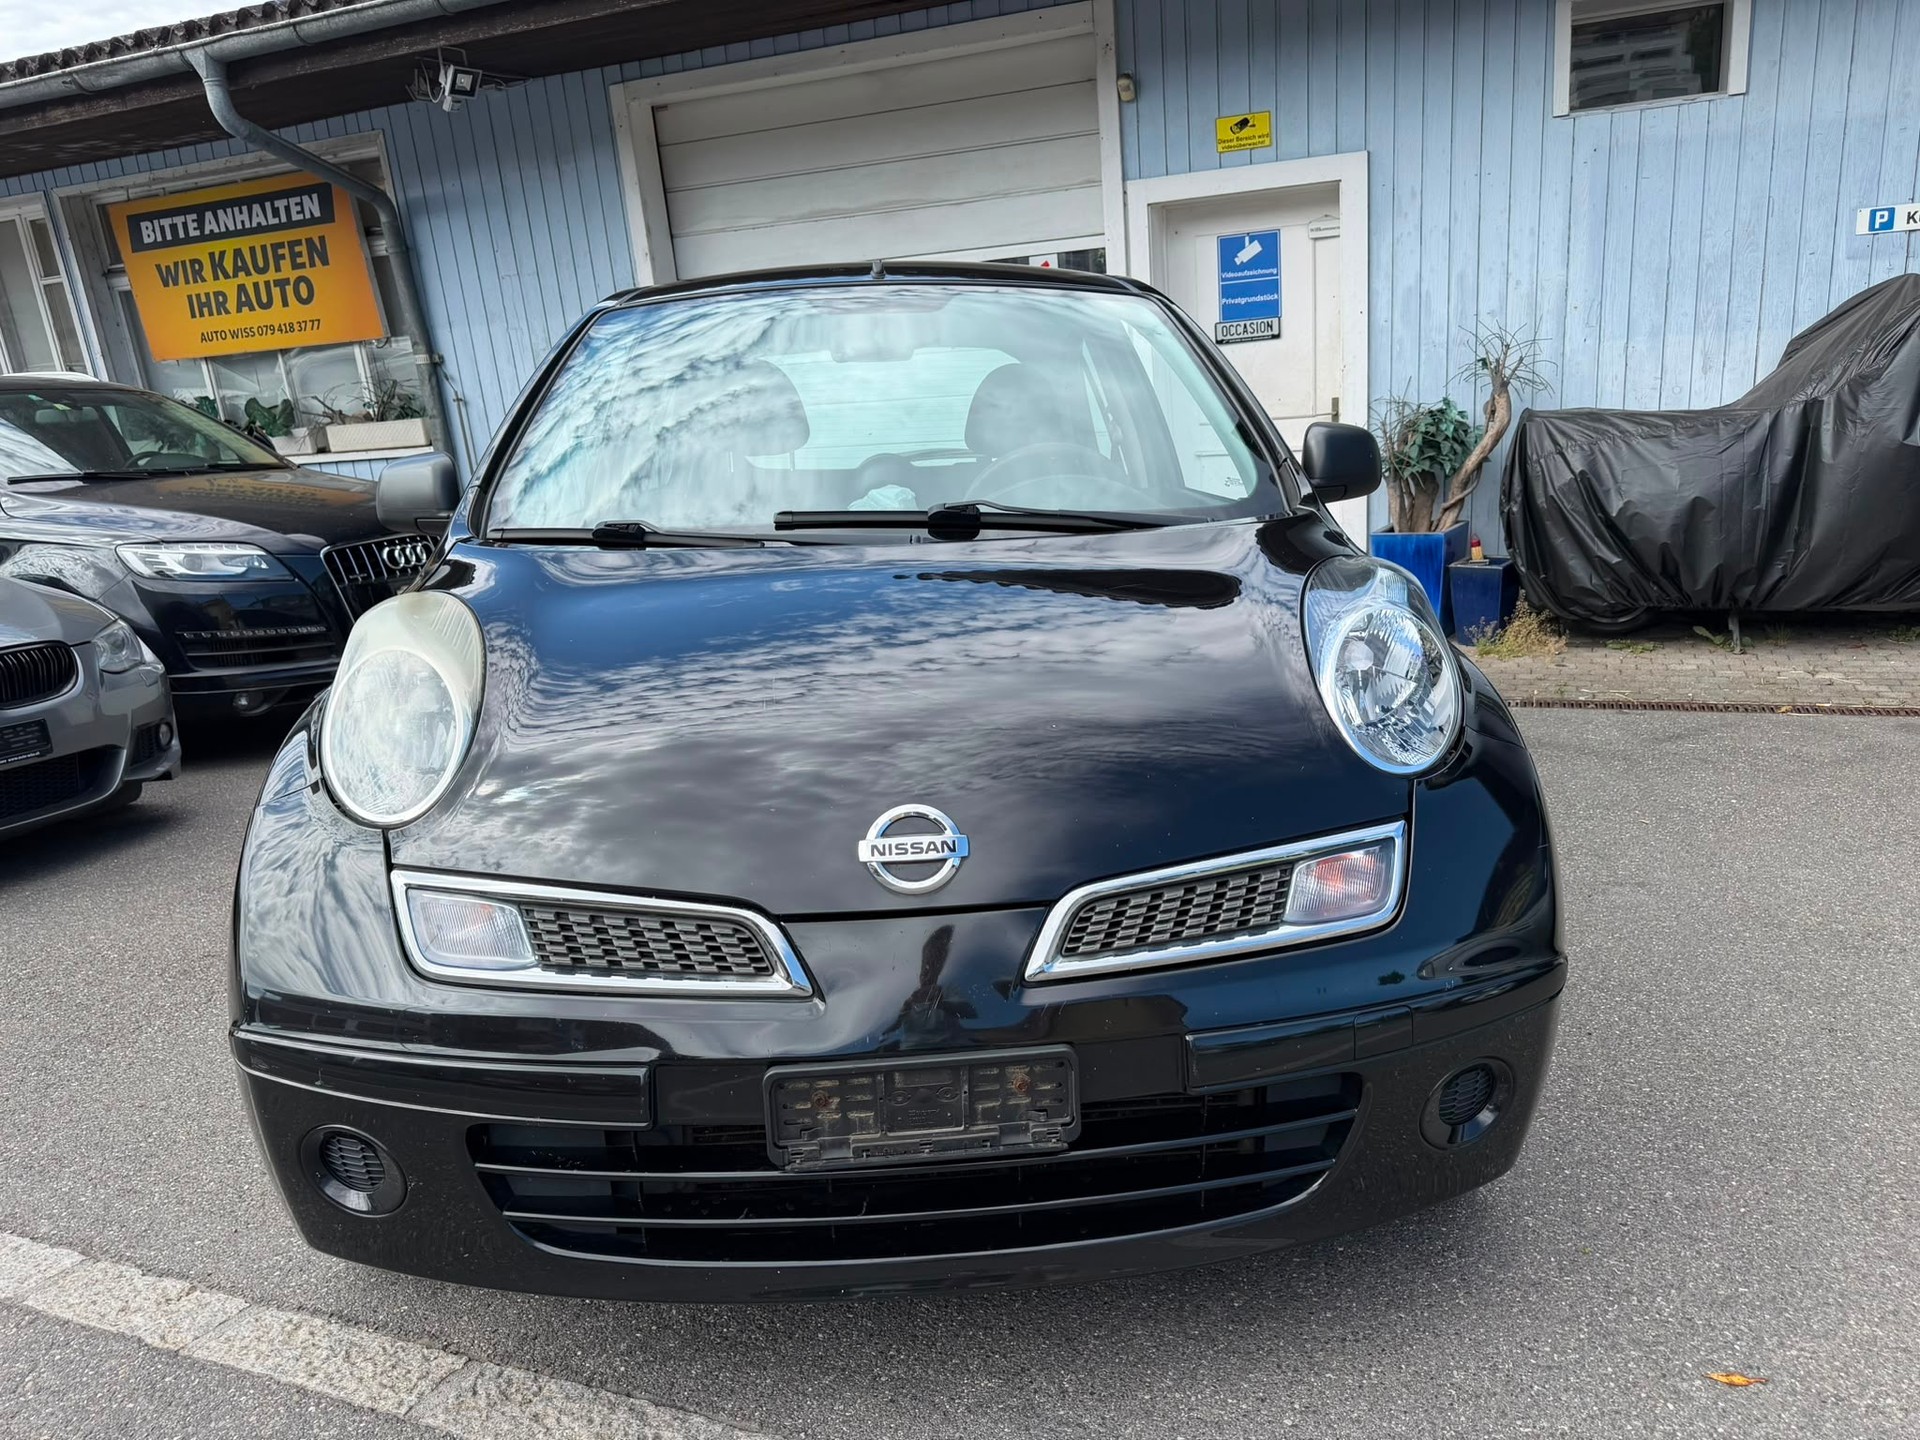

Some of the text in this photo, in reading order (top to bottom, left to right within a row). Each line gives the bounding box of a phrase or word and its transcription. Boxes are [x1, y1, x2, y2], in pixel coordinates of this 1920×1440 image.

[140, 193, 321, 245] BITTE ANHALTEN
[1874, 210, 1920, 229] P K
[155, 235, 330, 288] WIR KAUFEN
[187, 275, 315, 319] IHR AUTO
[1221, 293, 1279, 305] Privatgrundstück
[200, 330, 227, 343] AUTO
[228, 327, 256, 339] WISS
[256, 324, 276, 336] 079
[277, 322, 295, 334] 418
[1221, 320, 1274, 338] OCCASION
[870, 839, 957, 857] NISSAN
